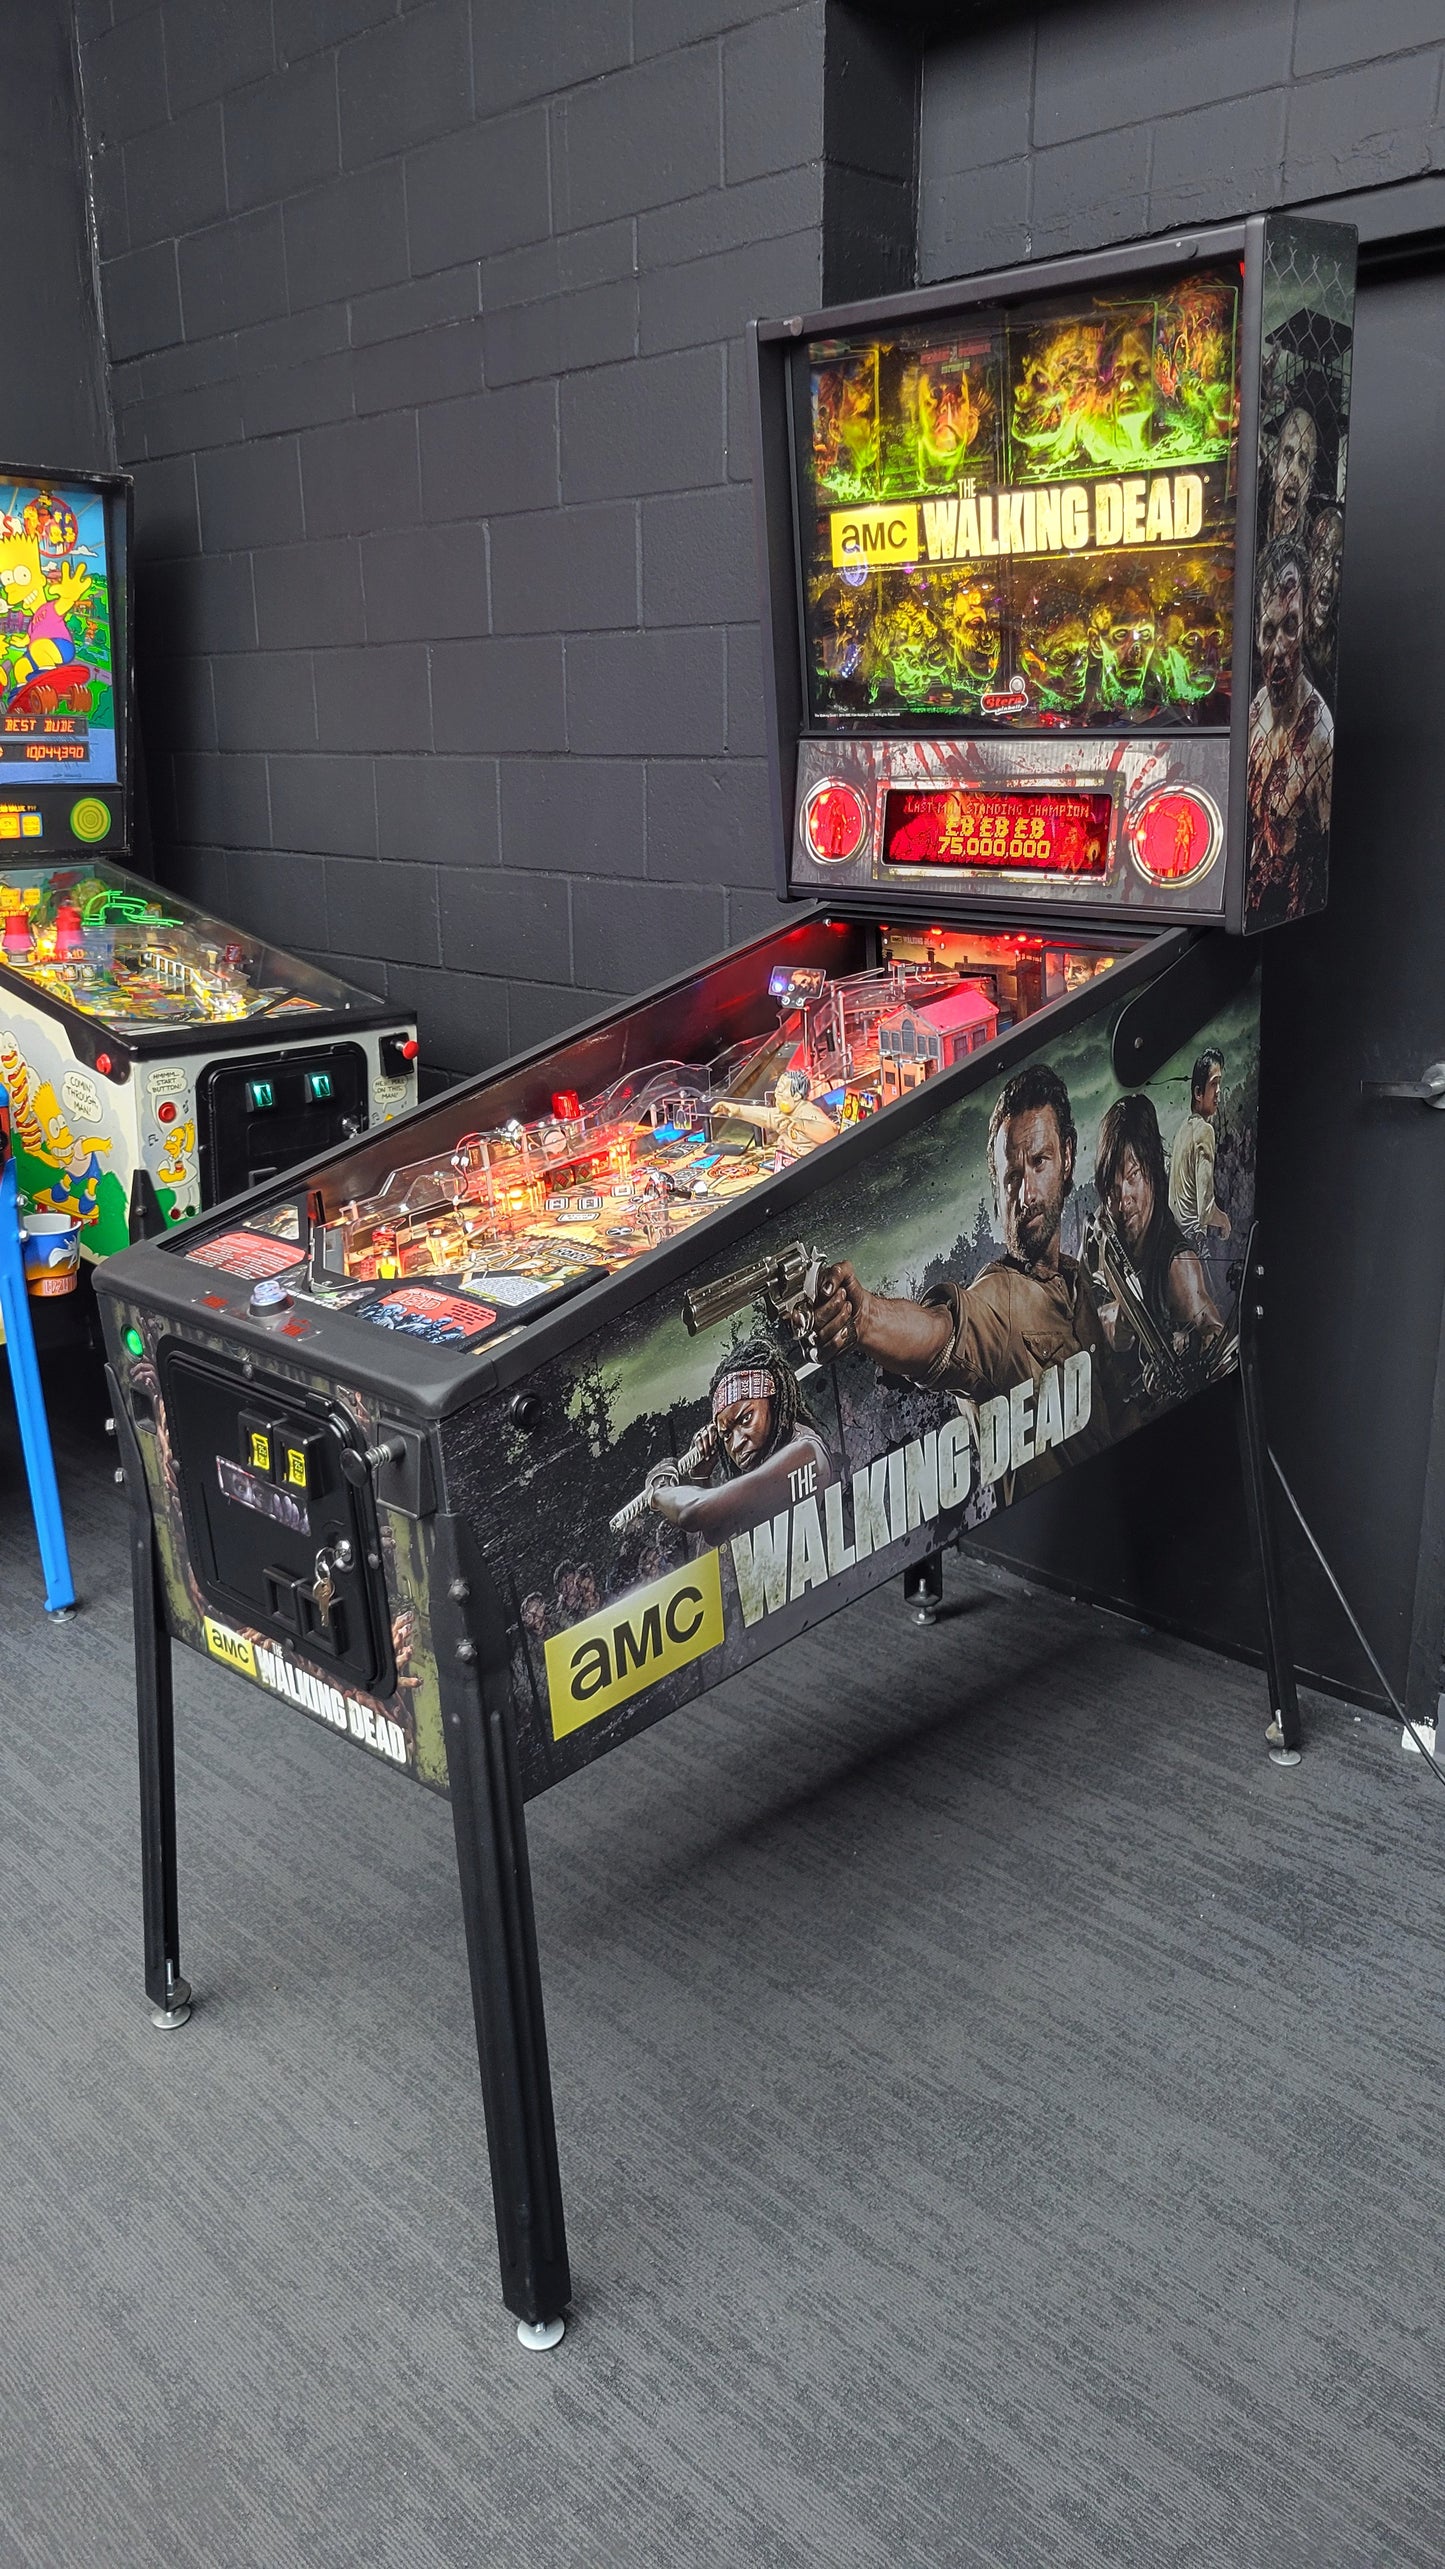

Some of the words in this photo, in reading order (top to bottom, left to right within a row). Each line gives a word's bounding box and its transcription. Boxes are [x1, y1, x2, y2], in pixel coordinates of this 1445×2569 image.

[957, 477, 977, 500] THE
[922, 485, 1090, 561] WALKING
[1095, 474, 1203, 547] DEAD
[983, 694, 1024, 709] Stern
[5, 717, 37, 732] BEST
[44, 718, 75, 733] DUDE
[908, 802, 932, 814] LAST
[966, 802, 1023, 815] STANDING
[1028, 803, 1090, 818] CHAMPION
[945, 815, 975, 837] EB
[979, 817, 1010, 838] EB
[1014, 818, 1046, 839] EB
[938, 836, 1051, 859] 75,000,000
[156, 1077, 177, 1086] START
[730, 1415, 971, 1629] WALKING
[977, 1350, 1093, 1487] DEAD
[787, 1460, 819, 1503] THE
[271, 1641, 284, 1660] THE
[254, 1644, 348, 1731] WALKING
[347, 1696, 407, 1764] DEAD
